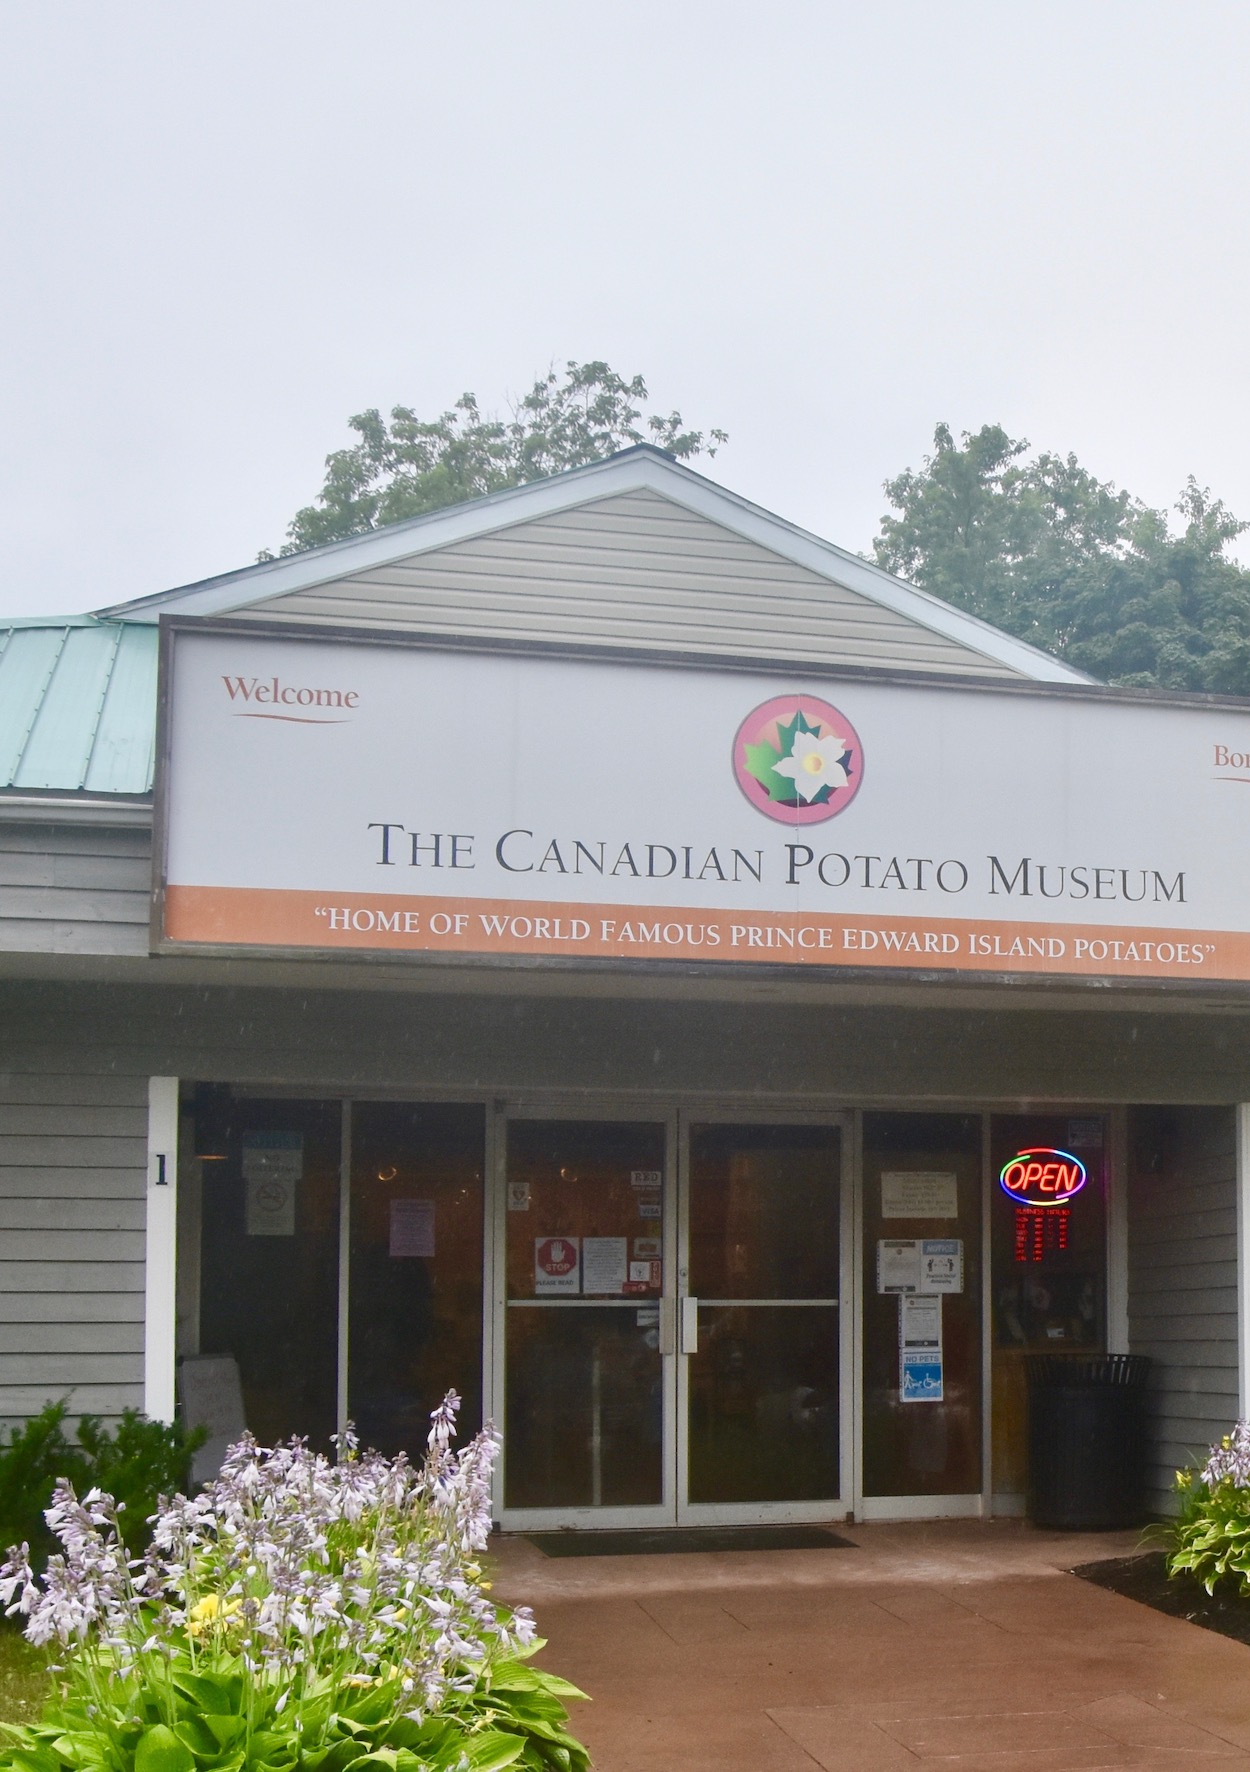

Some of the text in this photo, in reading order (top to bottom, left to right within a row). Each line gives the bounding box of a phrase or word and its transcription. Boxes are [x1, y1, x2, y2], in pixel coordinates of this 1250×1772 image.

[221, 674, 361, 709] Welcome
[367, 822, 1188, 903] THE CANADIAN POTATO MUSEUM
[314, 906, 1216, 965] “HOME OF WORLD FAMOUS PRINCE EDWARD ISLAND POTATOES”
[155, 1154, 168, 1186] 1
[1004, 1162, 1079, 1191] OPEN
[926, 1244, 955, 1253] NOTICE
[545, 1263, 571, 1272] STOP
